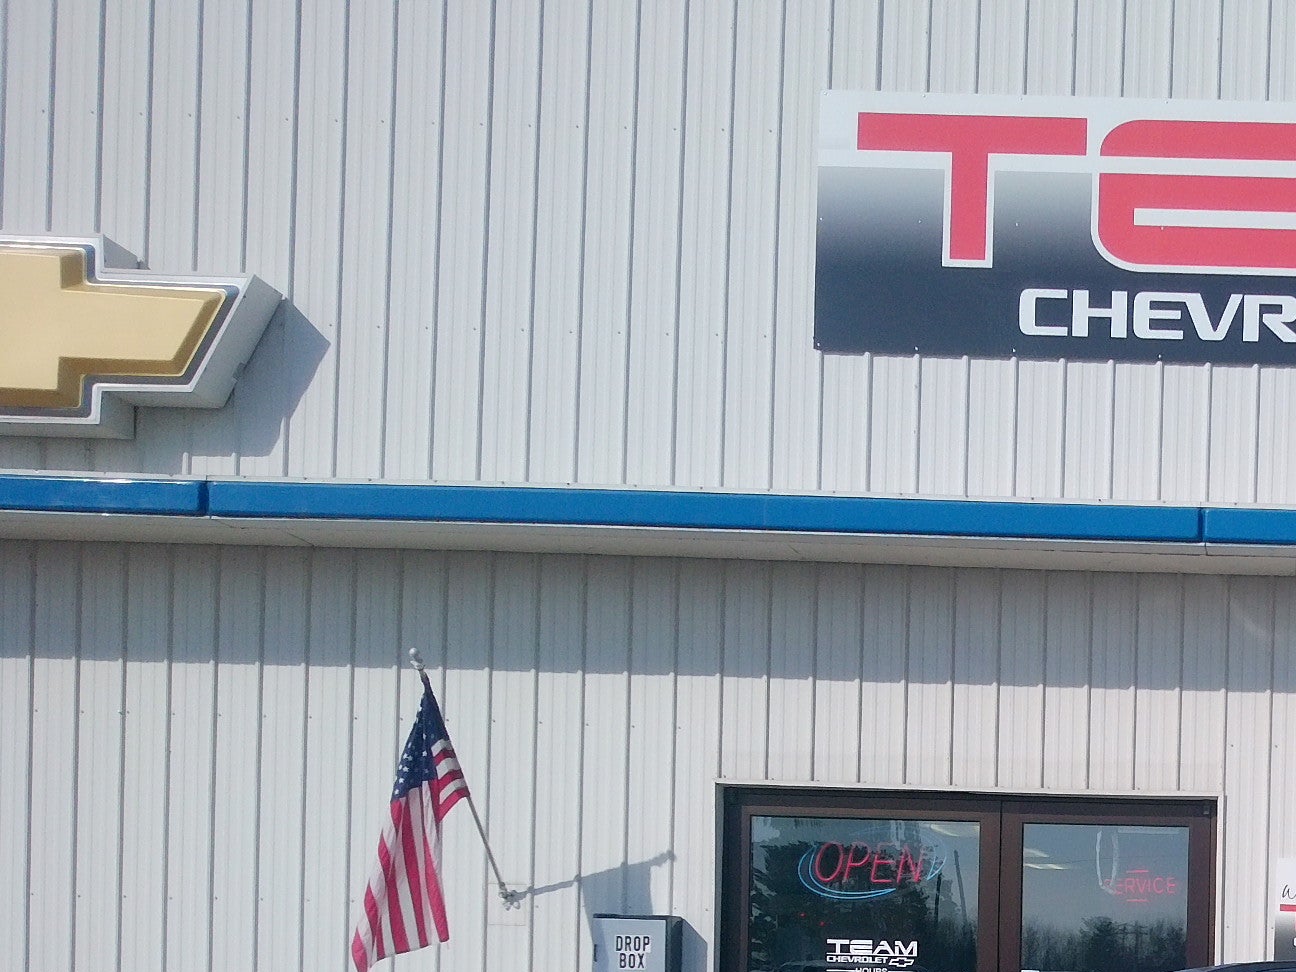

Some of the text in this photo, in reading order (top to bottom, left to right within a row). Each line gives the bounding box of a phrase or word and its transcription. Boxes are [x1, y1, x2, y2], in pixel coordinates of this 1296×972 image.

[813, 841, 926, 885] OPEN
[615, 936, 651, 952] DROP
[827, 939, 918, 957] TEAM
[619, 953, 645, 969] BOX
[827, 955, 889, 964] CHEVROLET
